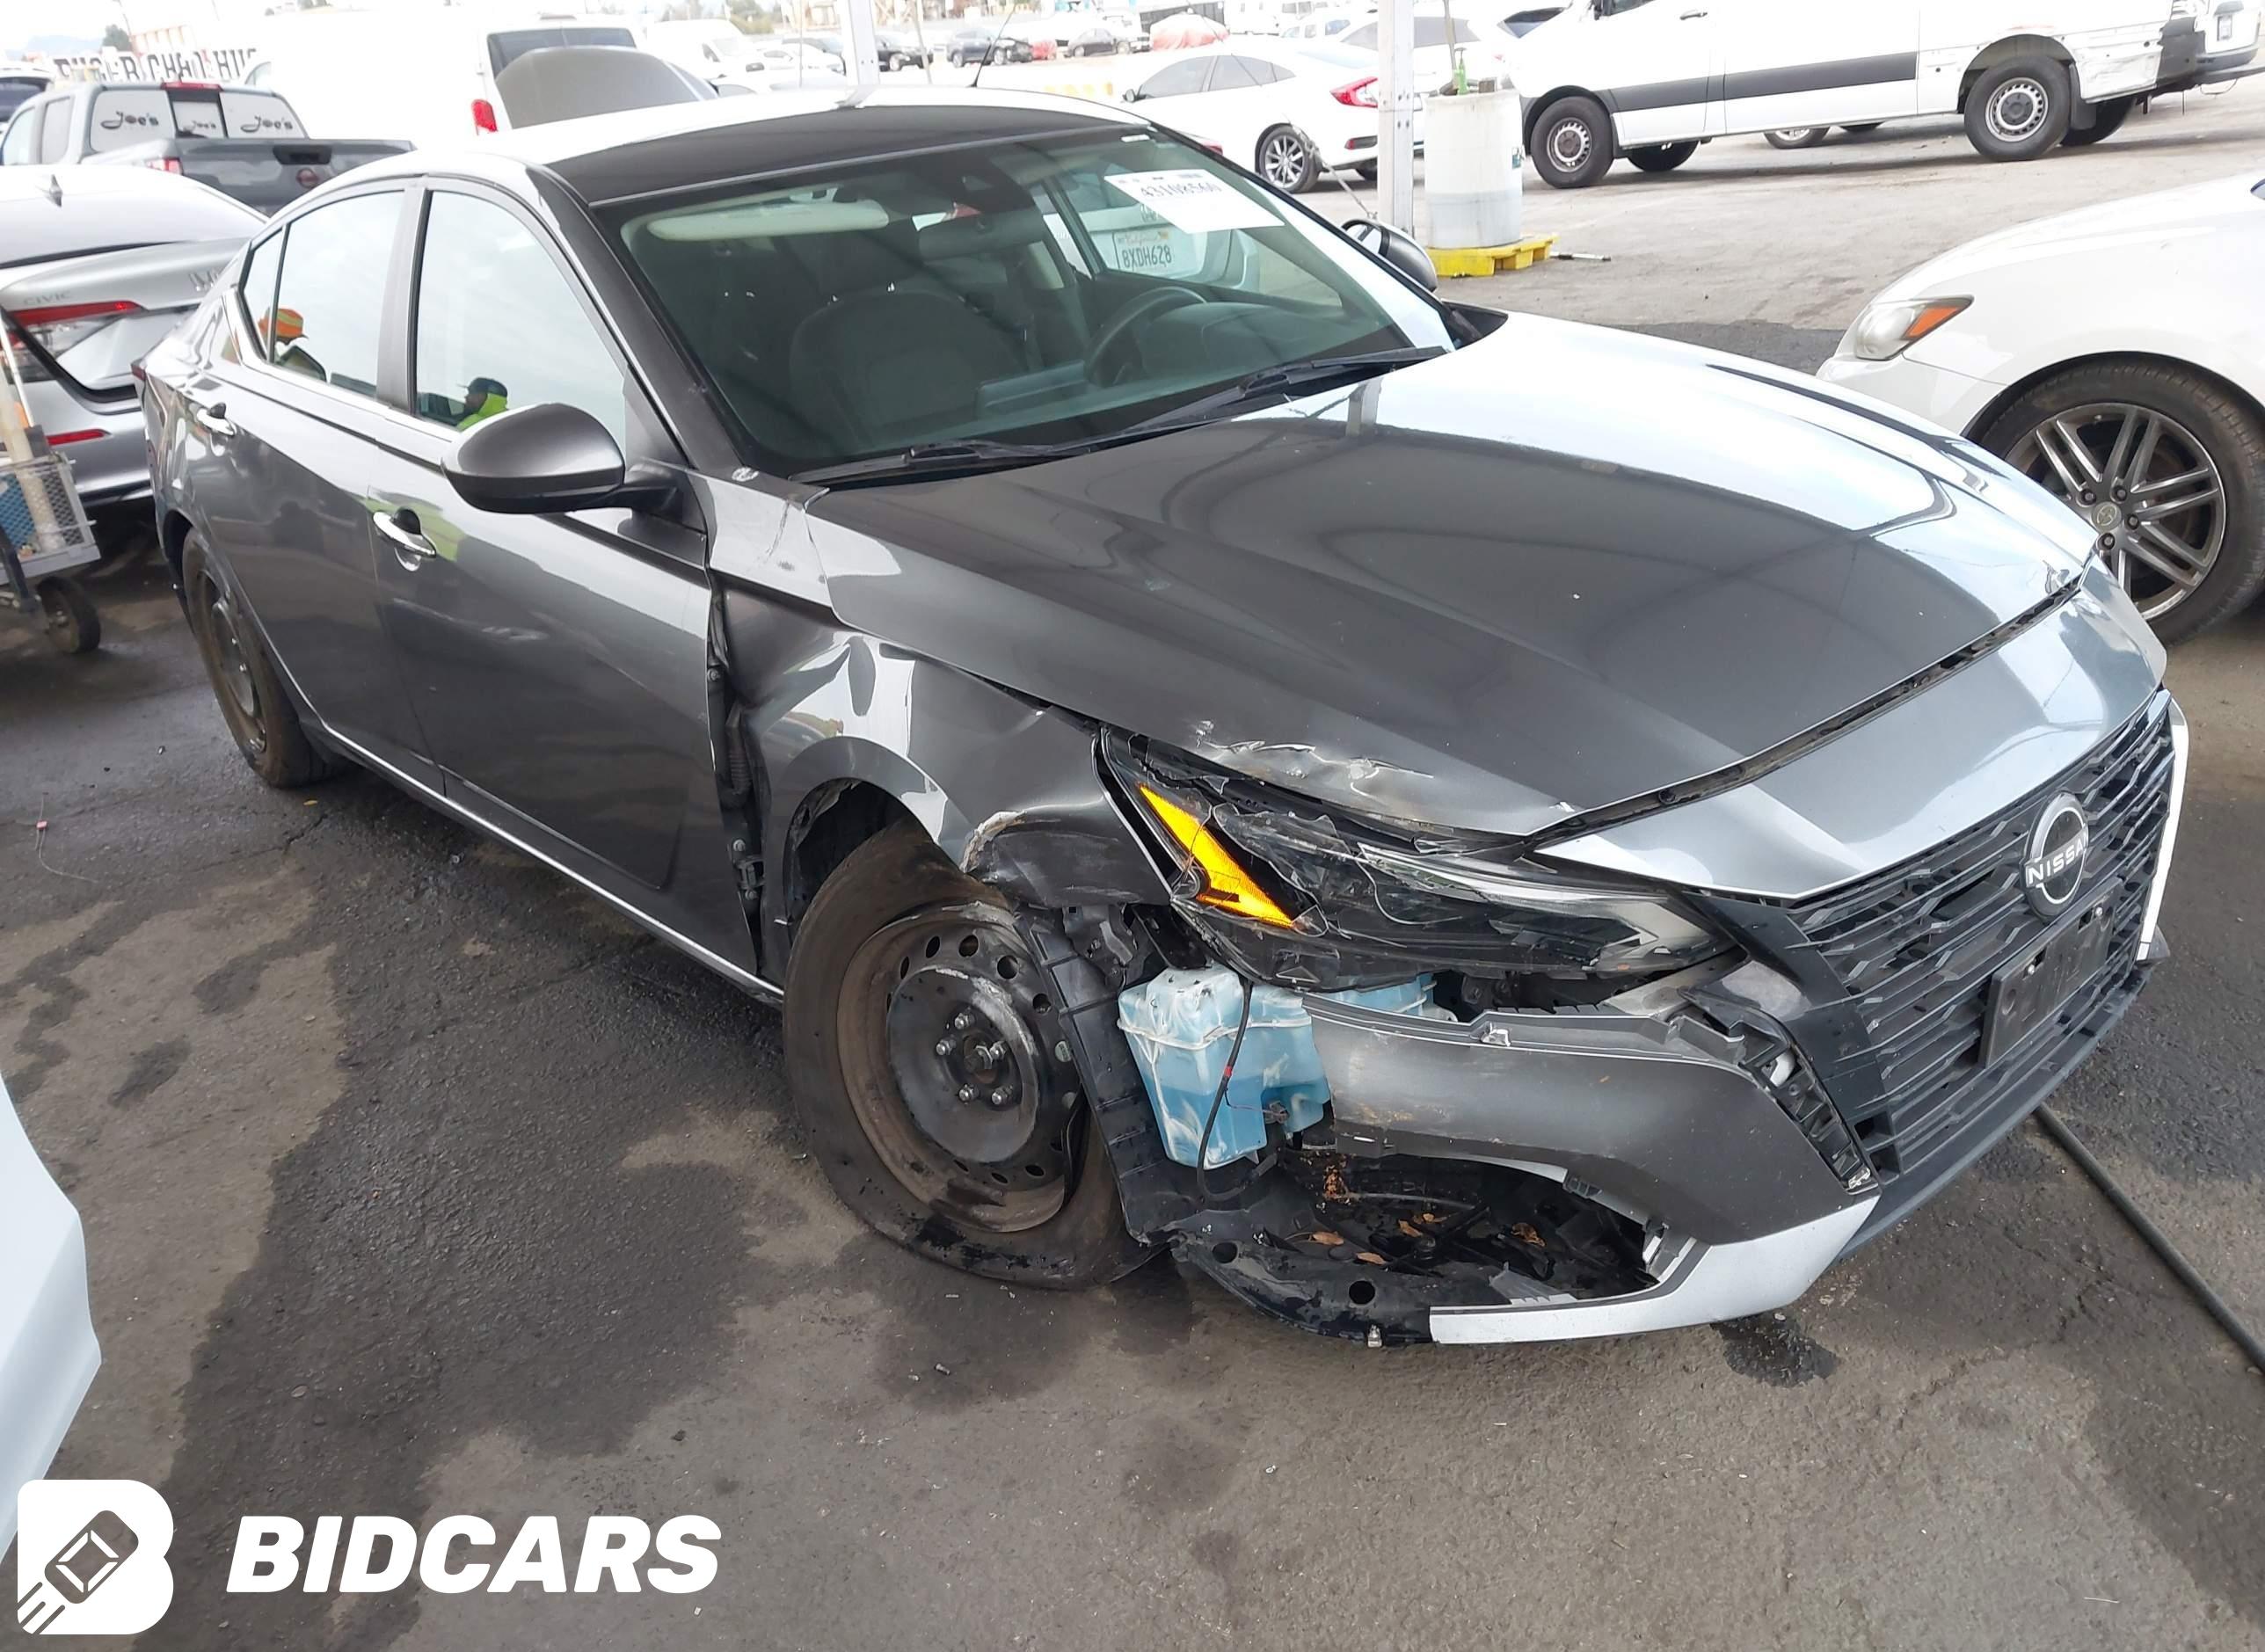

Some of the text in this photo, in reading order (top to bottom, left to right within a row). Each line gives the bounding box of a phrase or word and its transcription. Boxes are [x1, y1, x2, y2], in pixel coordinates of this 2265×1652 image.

[100, 111, 159, 130] Joe's
[240, 116, 294, 133] Joe's
[1121, 244, 1172, 268] 8XDH628
[23, 290, 72, 306] CIVIC
